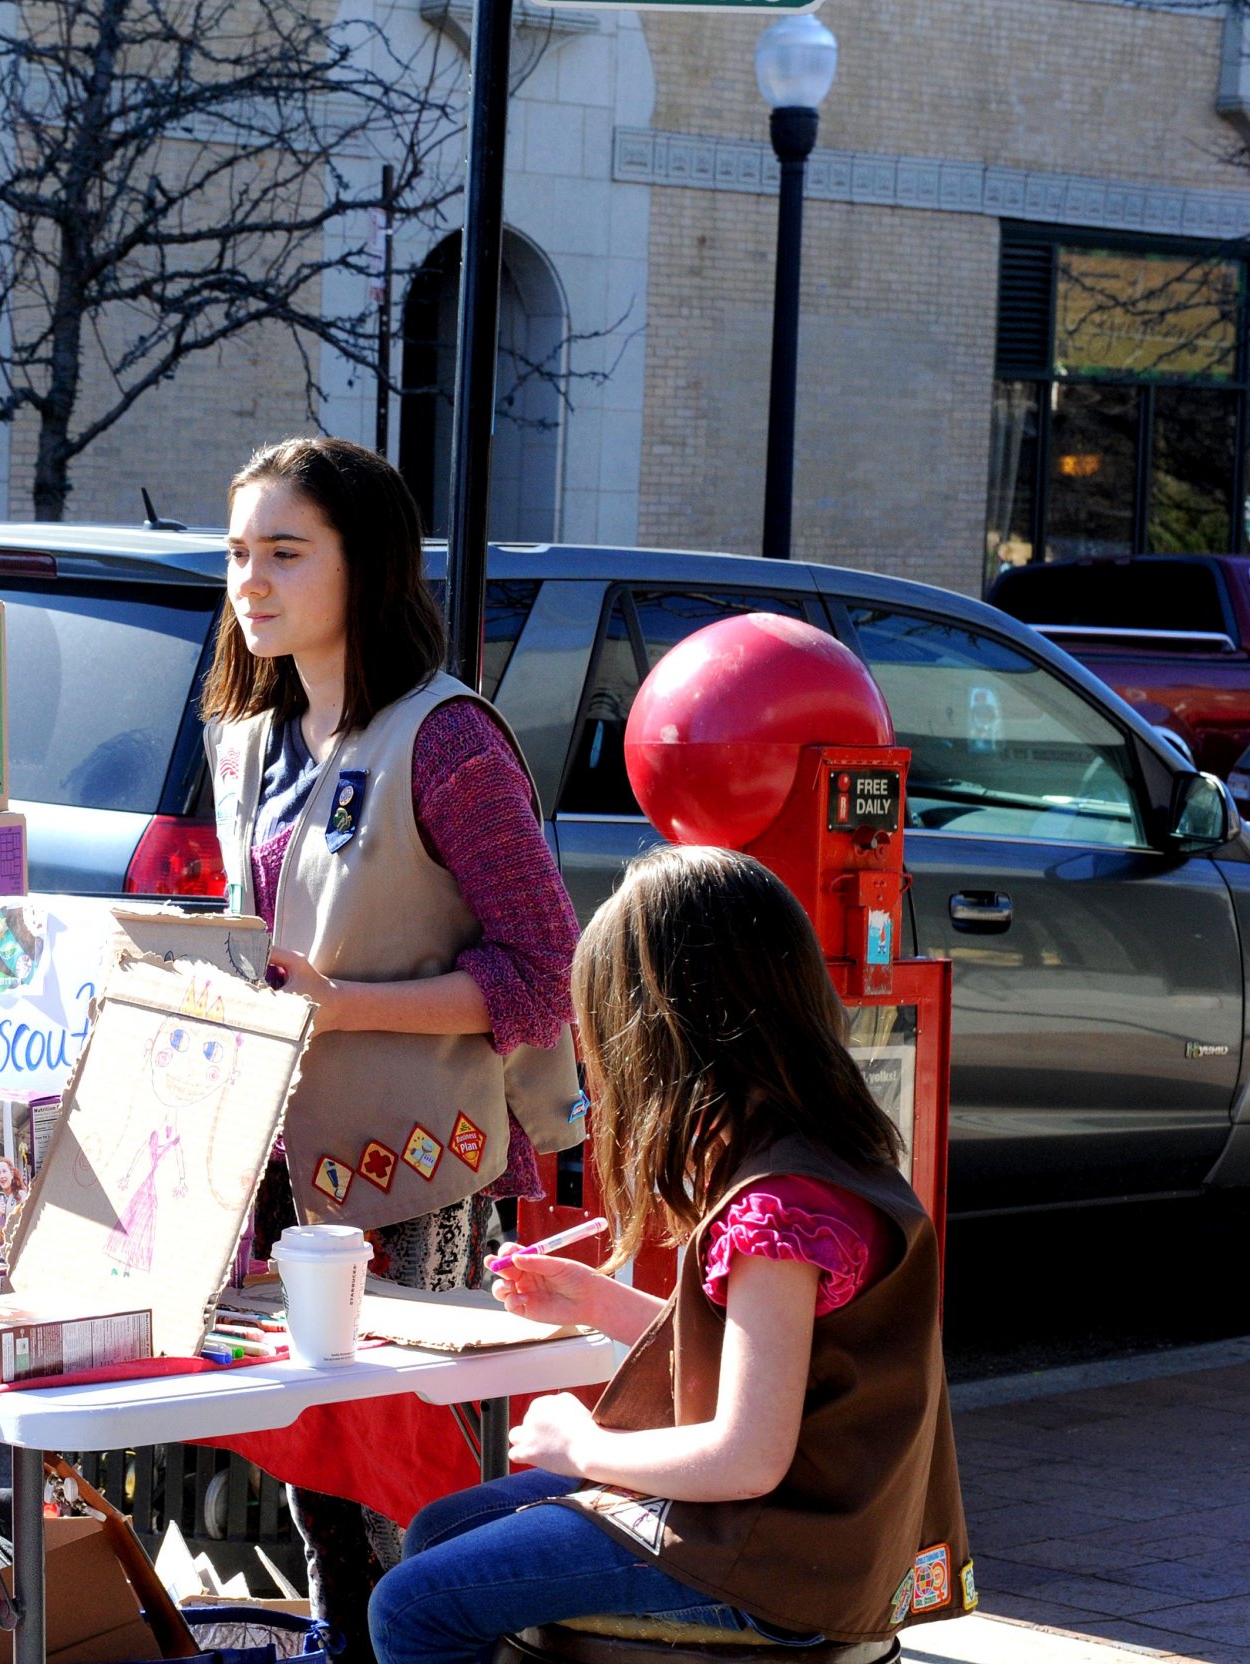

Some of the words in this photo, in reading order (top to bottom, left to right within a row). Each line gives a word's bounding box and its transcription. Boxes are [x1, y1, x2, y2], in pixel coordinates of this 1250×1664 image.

[856, 779, 888, 795] FREE
[856, 799, 891, 815] DAILY
[869, 1069, 897, 1084] yolks!
[460, 1141, 478, 1153] Plan
